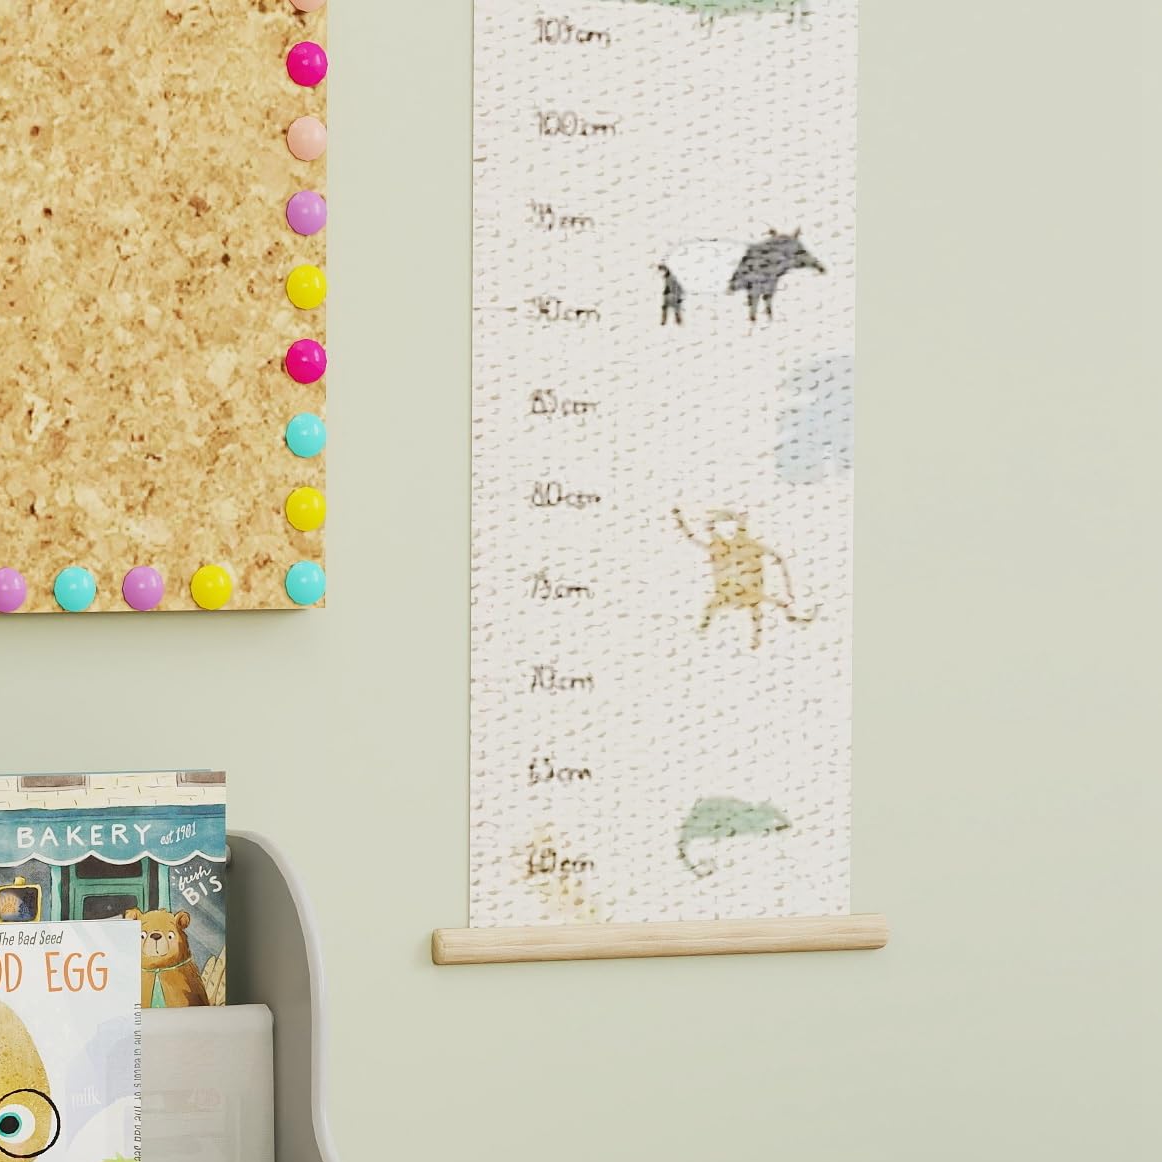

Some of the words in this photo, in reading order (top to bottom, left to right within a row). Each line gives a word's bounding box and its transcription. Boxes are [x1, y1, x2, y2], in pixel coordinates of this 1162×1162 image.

[16, 823, 152, 848] BAKERY
[174, 821, 197, 843] 1901
[178, 865, 212, 891] fresh
[17, 931, 37, 946] Bad
[39, 930, 64, 945] Seed
[45, 952, 109, 992] EGG
